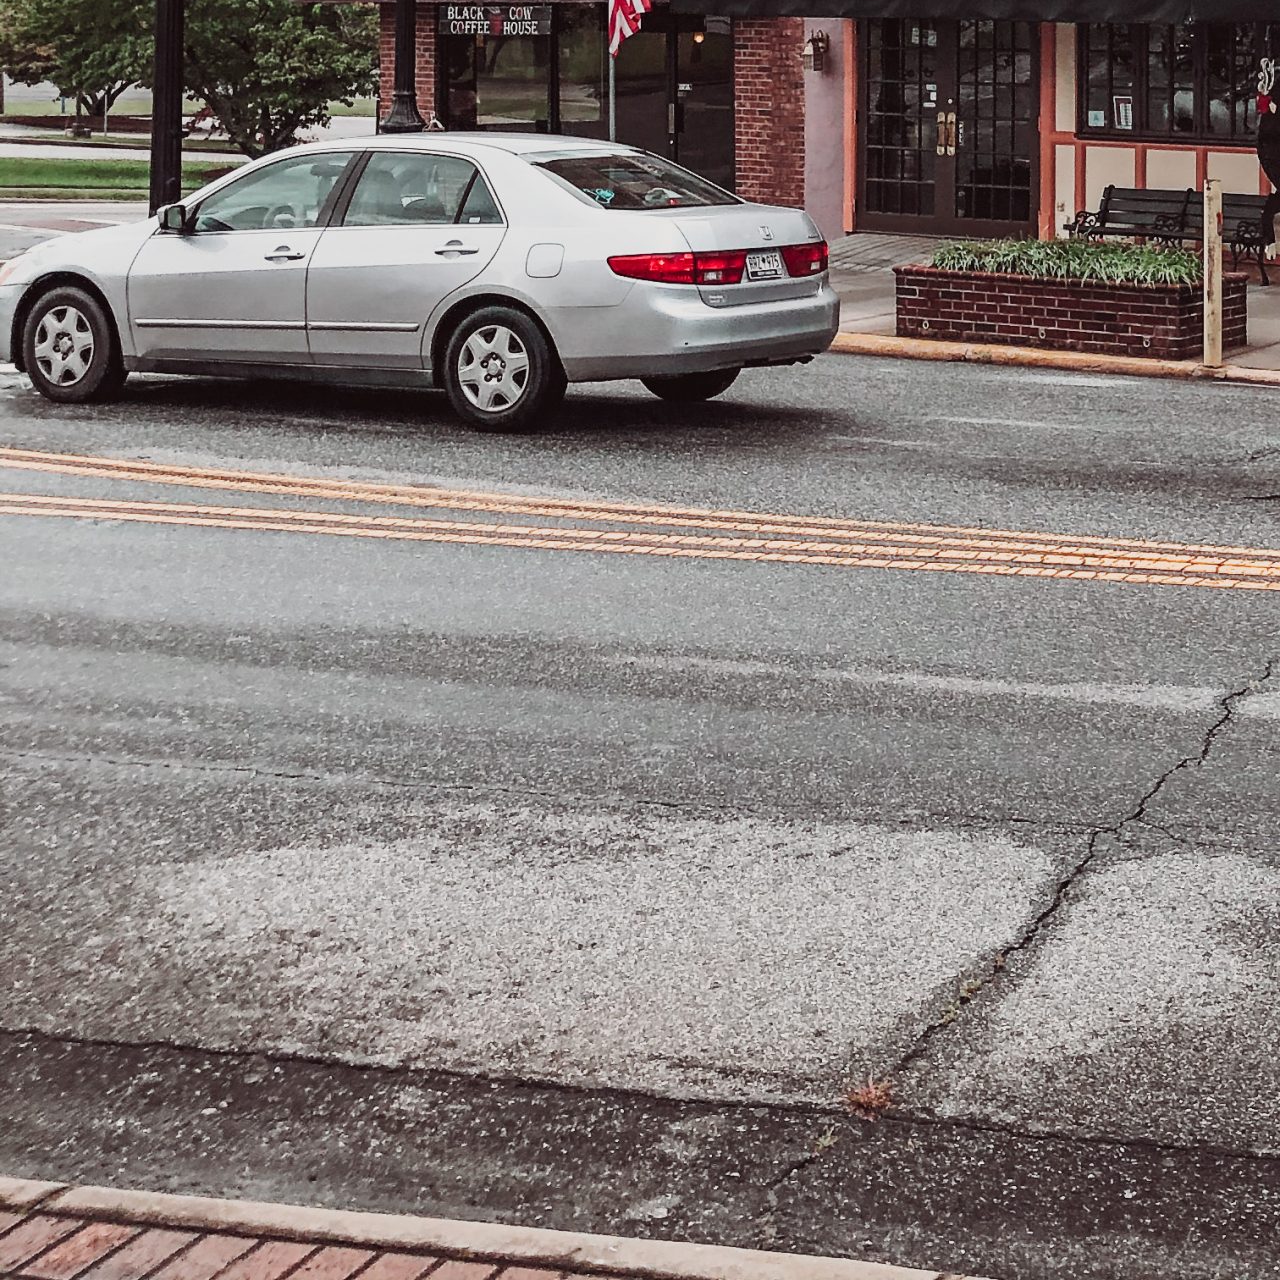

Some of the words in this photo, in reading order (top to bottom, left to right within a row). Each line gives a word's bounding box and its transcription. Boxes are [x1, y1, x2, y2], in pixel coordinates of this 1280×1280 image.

[447, 6, 484, 20] BLACK
[509, 6, 534, 20] COW
[450, 21, 490, 34] COFFEE
[503, 21, 538, 35] HOUSE
